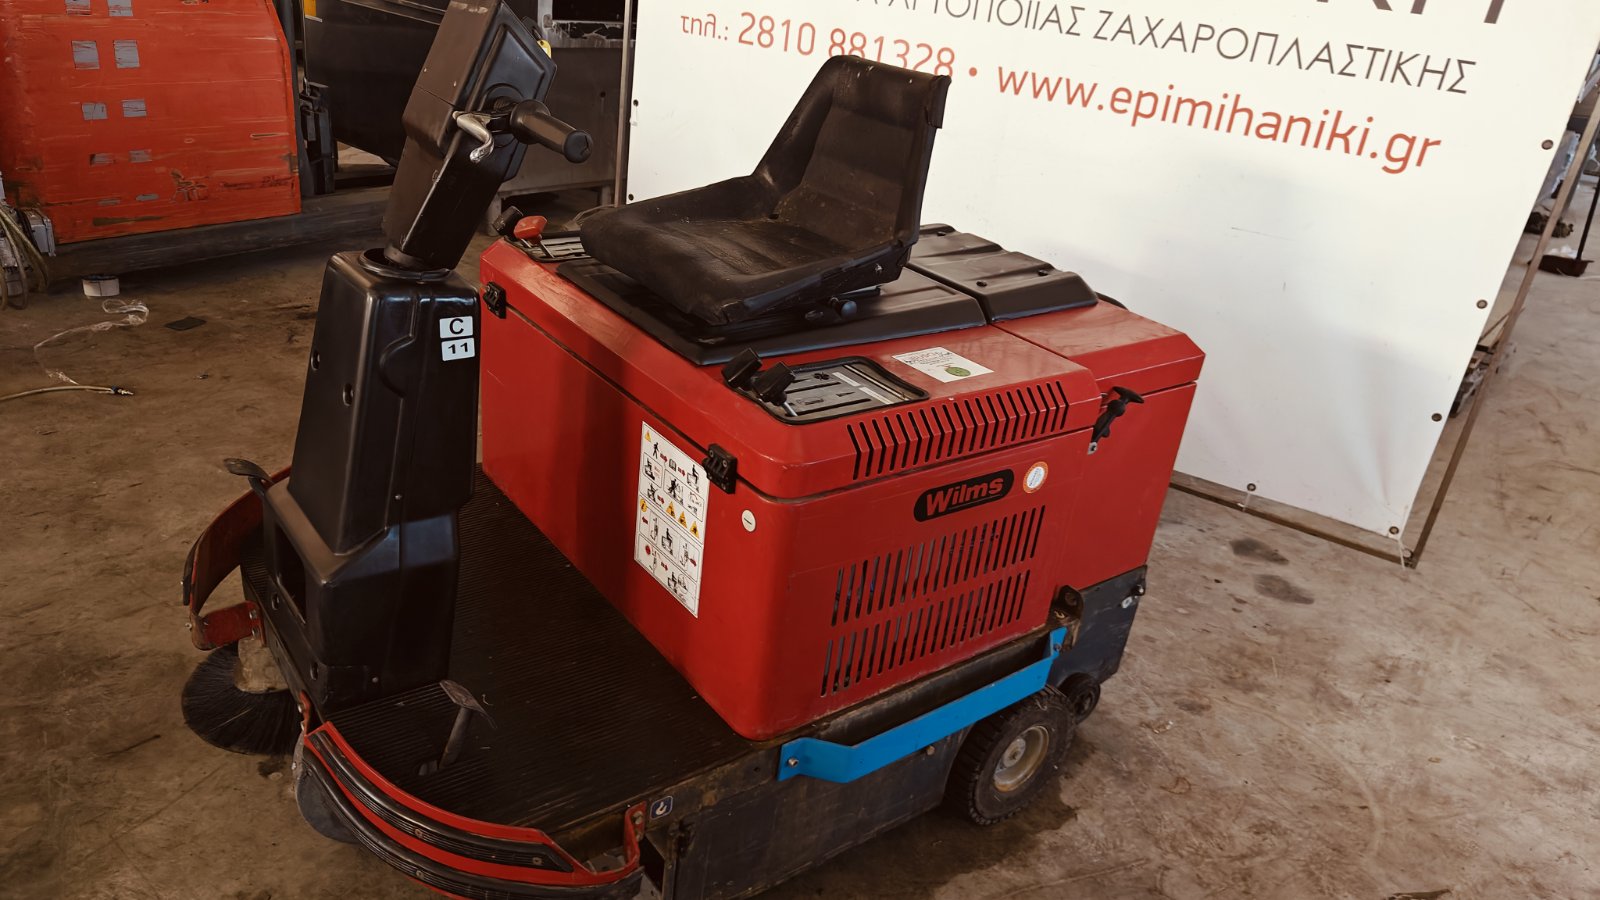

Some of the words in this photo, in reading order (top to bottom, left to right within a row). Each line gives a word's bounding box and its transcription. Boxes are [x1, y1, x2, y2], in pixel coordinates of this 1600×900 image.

[1093, 10, 1476, 94] ΖΑΧΑΡΟΠΛΑΣΤΙΚΗΣ
[681, 13, 728, 40] τηλ.:
[738, 12, 816, 56] 2810
[828, 27, 956, 78] 881328
[998, 66, 1441, 174] www.epimihaniki.gr
[449, 318, 464, 335] C
[447, 342, 469, 355] 11
[926, 477, 1004, 516] Wilms
